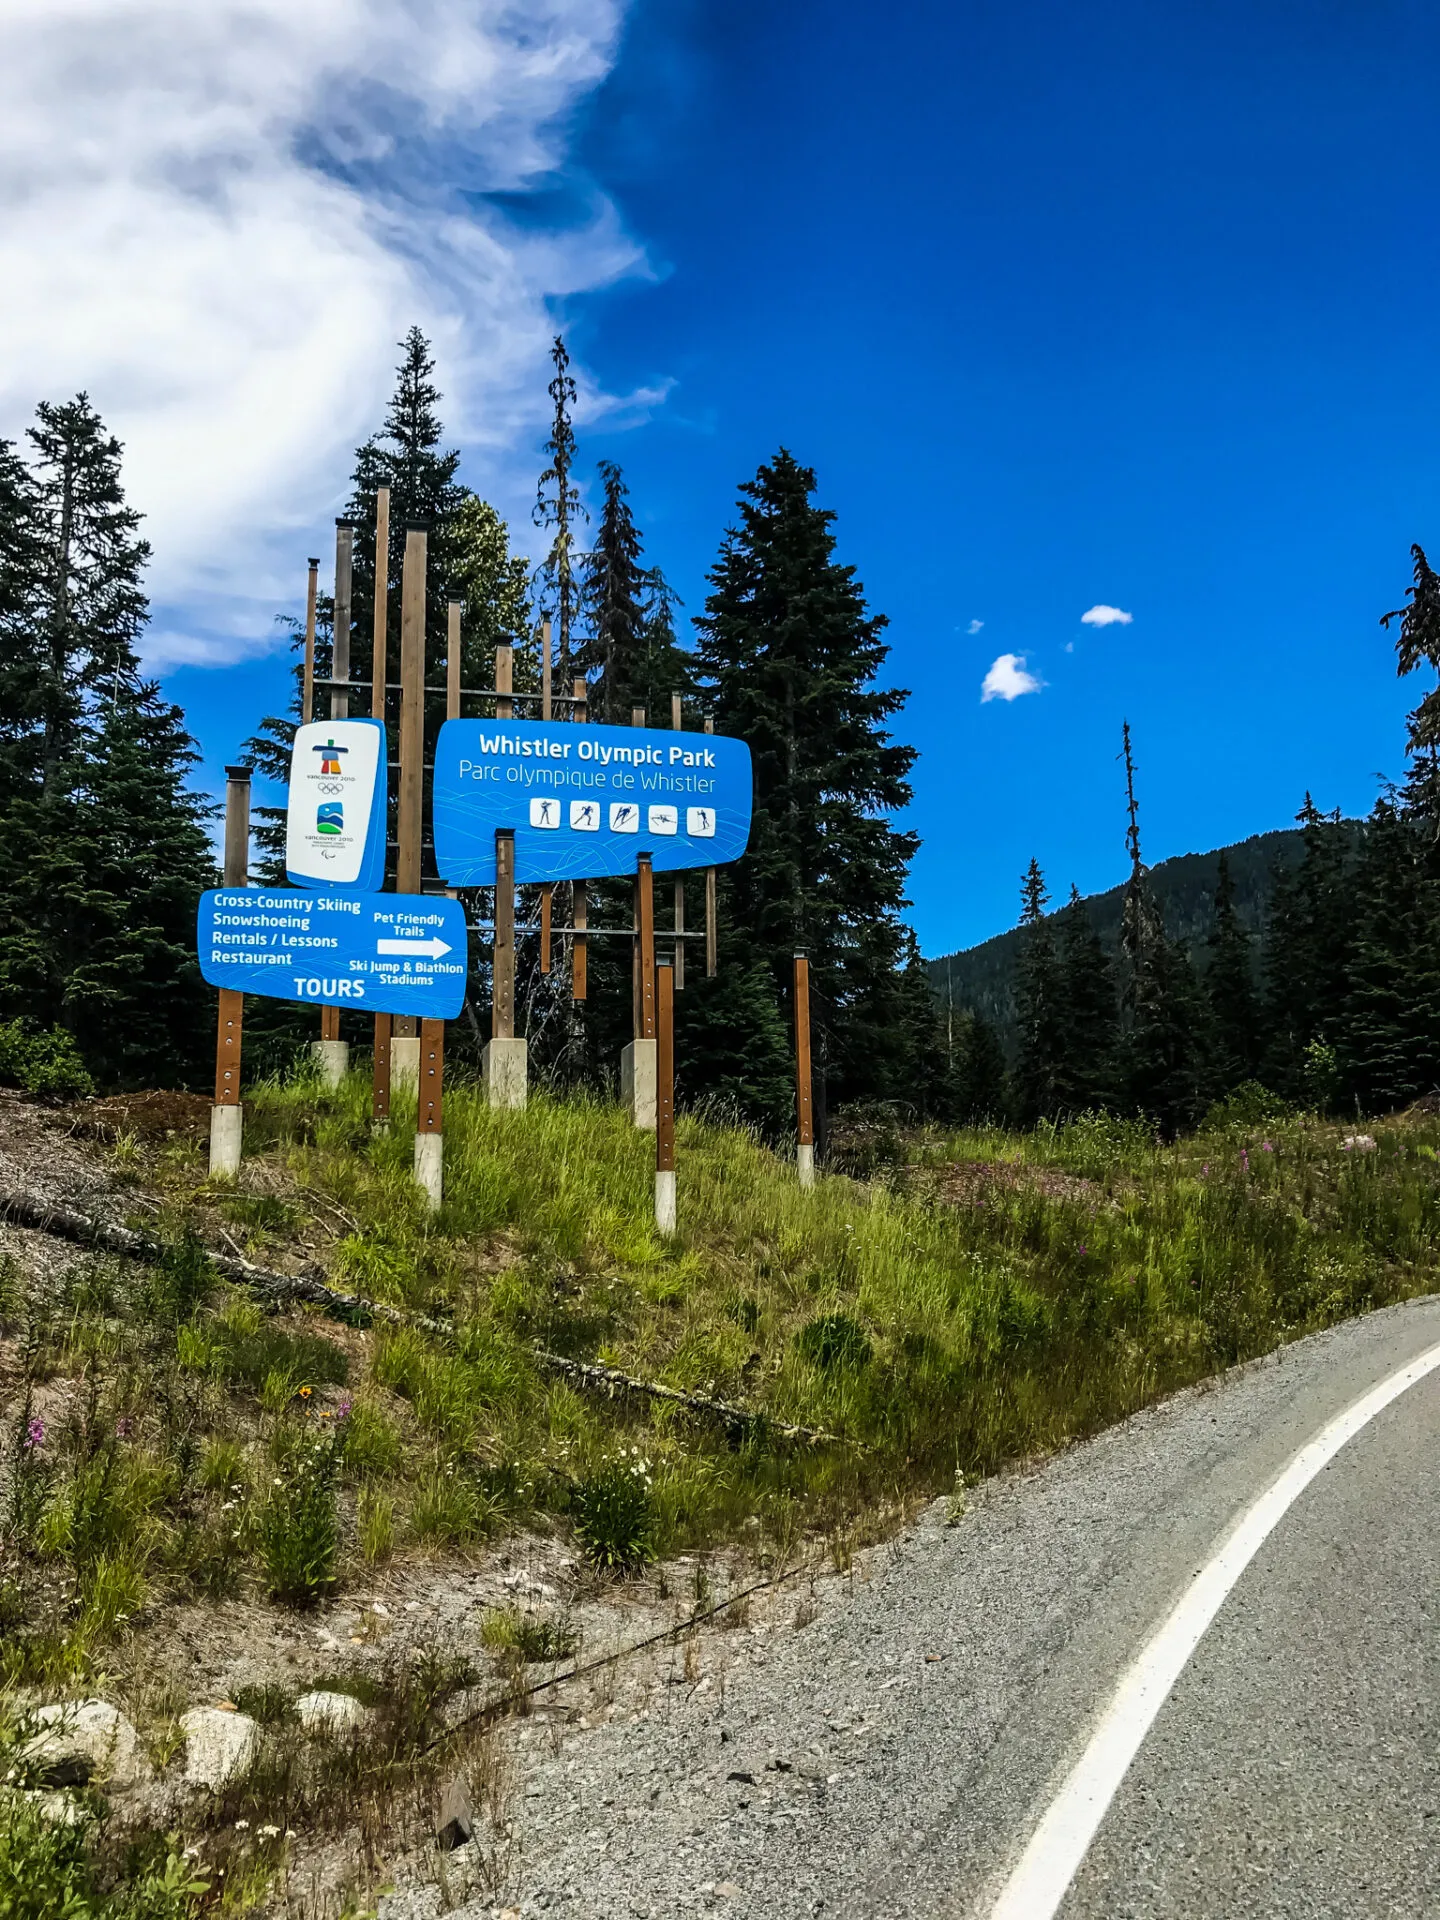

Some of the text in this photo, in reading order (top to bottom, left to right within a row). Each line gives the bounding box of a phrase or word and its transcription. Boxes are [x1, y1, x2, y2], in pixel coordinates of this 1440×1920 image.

[480, 734, 716, 768] Whistler Olympic Park
[459, 760, 716, 793] Parc olympique de Whistler
[213, 893, 361, 915] Cross-Country Skiing
[213, 912, 310, 931] Snowshoeing
[374, 912, 445, 927] Pet Friendly
[212, 931, 267, 946] Rentals
[281, 933, 338, 948] Lessons
[394, 925, 425, 937] Trails
[211, 950, 292, 966] Restaurant
[349, 960, 464, 974] Ski Jump & Biathlon
[293, 977, 366, 998] TOURS
[379, 974, 434, 986] Stadiums
